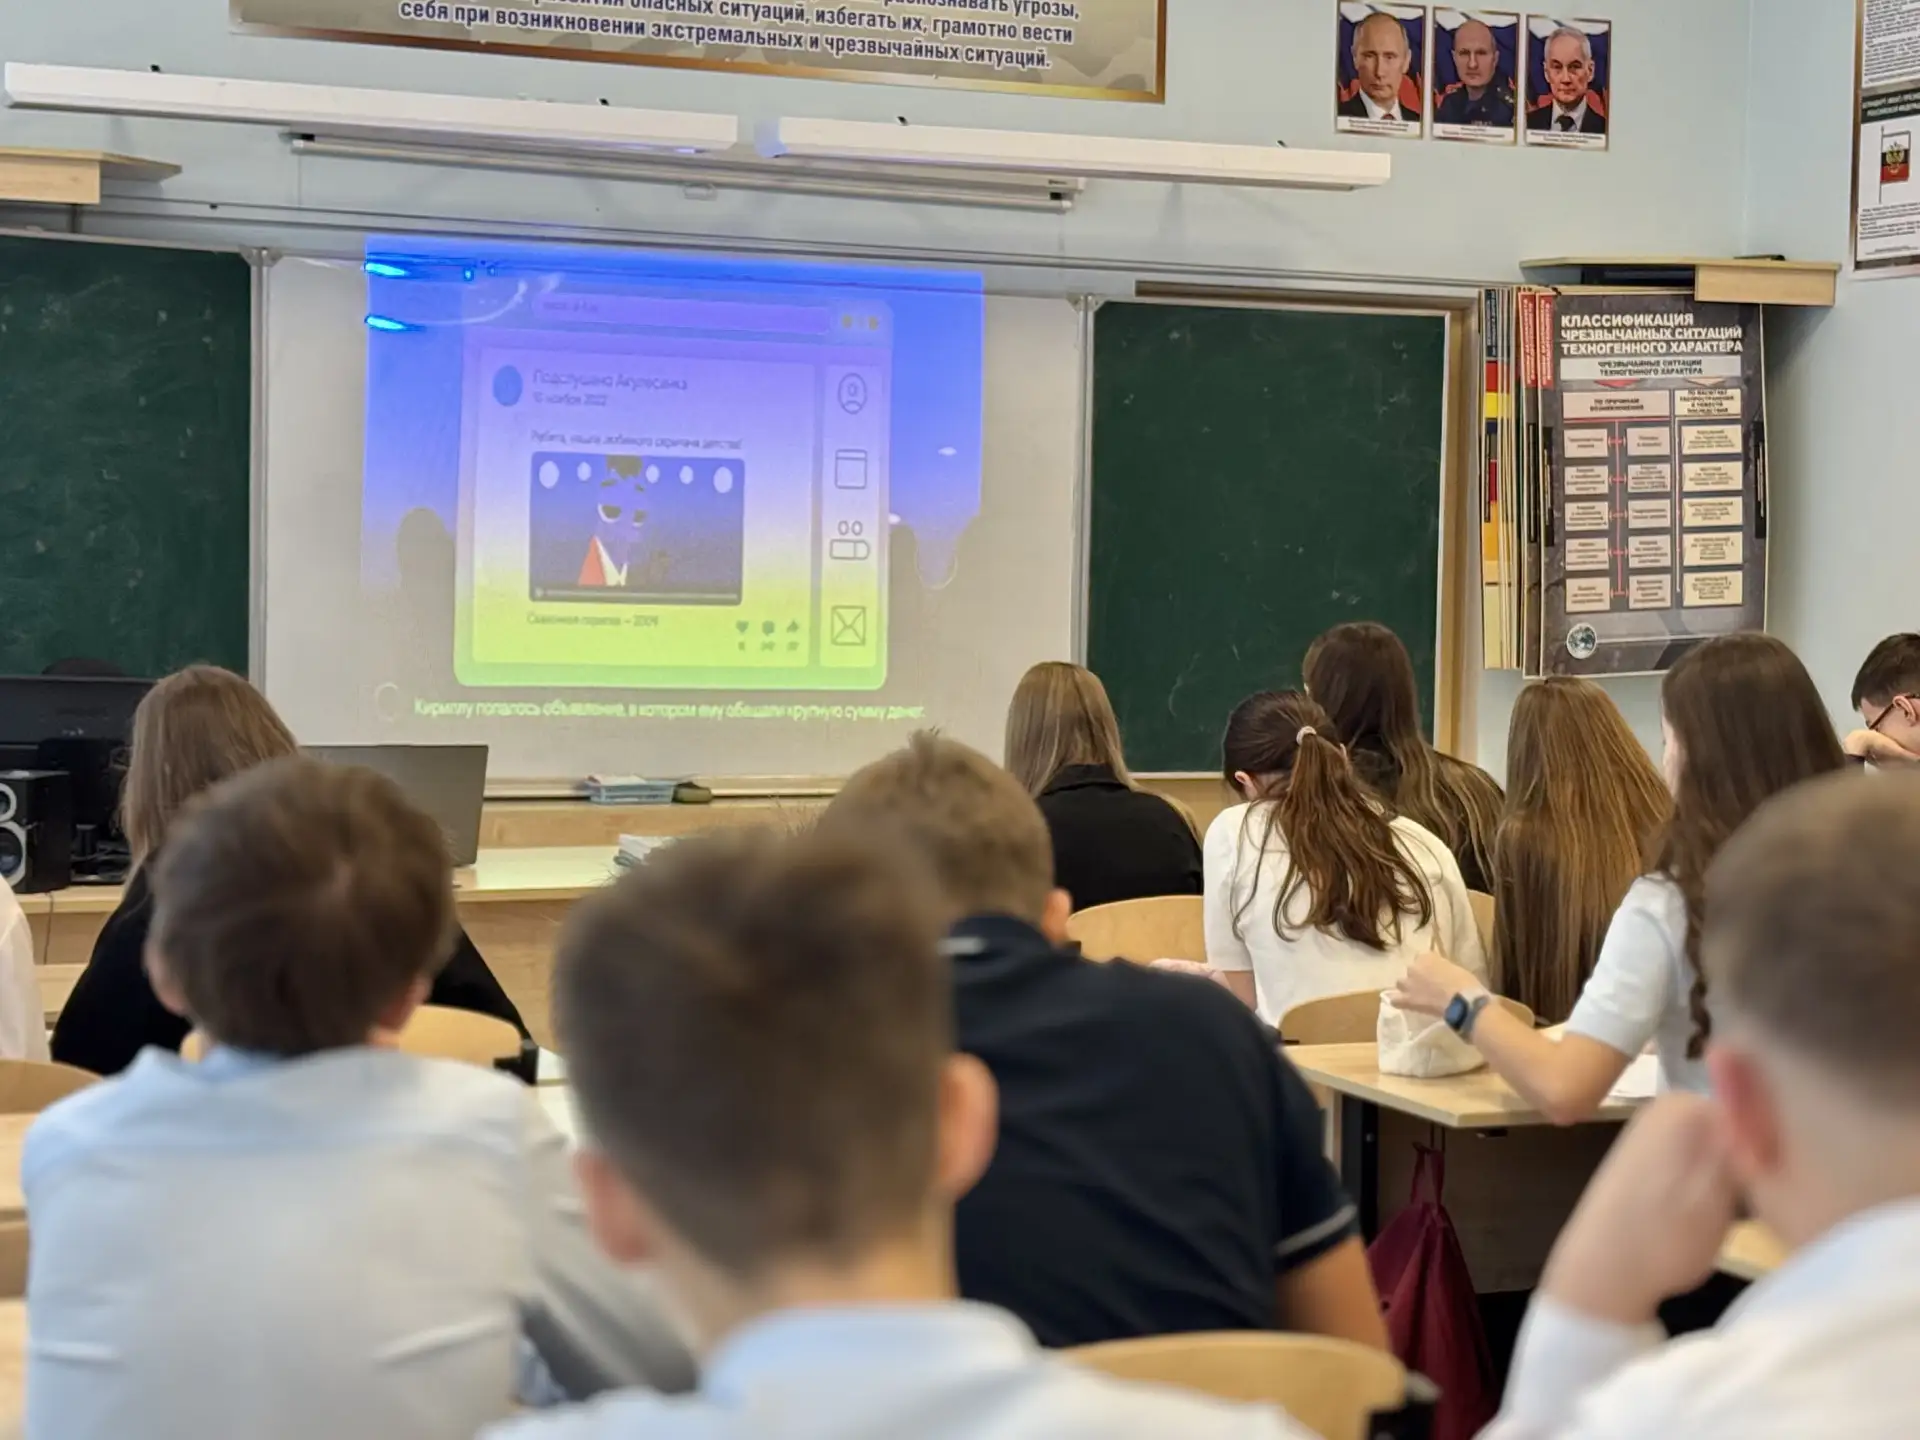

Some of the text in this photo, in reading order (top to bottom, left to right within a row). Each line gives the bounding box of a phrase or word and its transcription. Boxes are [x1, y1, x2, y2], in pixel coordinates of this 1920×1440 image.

[1014, 0, 1080, 19] угрозы,
[719, 1, 809, 23] ситуаций,
[815, 7, 896, 29] избегать
[902, 16, 928, 33] их,
[933, 19, 1017, 38] грамотно
[1023, 28, 1072, 43] вести
[400, 2, 1050, 68] себя при возникновении экстремальных и чрезвычайных ситуаций.
[1561, 313, 1694, 328] КЛАССИФИКАЦИЯ
[1561, 325, 1742, 341] ЧРЕЗВЫЧАЙНЫХ СИТУАЦИЙ
[1561, 340, 1743, 355] ТЕХНОГЕННОГО ХАРАКТЕРА
